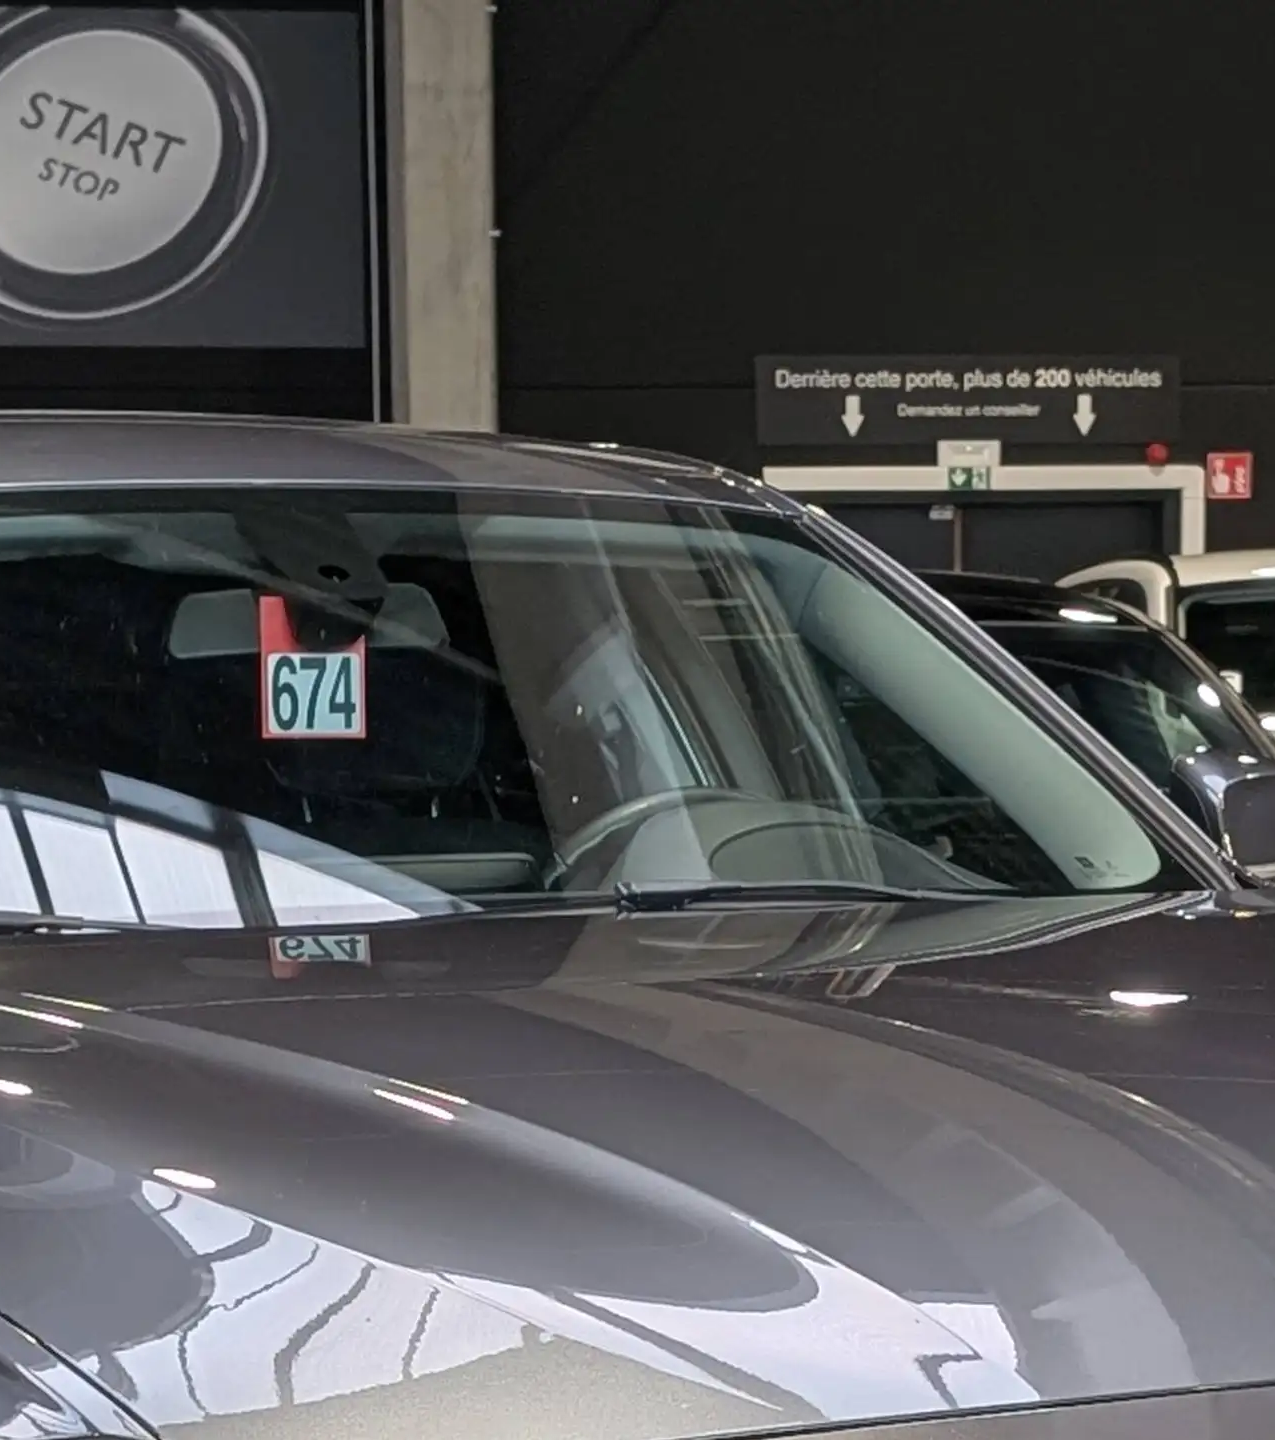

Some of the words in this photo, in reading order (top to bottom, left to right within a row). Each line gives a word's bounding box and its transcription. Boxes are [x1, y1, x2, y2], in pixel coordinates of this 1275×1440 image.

[20, 91, 186, 173] START
[38, 157, 120, 200] STOP
[775, 369, 852, 389] Derrière
[854, 371, 902, 388] cette
[905, 371, 960, 392] porte,
[963, 368, 1004, 392] plus
[1006, 368, 1032, 388] de
[1034, 368, 1072, 388] 200
[1075, 367, 1163, 388] véhicules
[271, 655, 356, 731] 674
